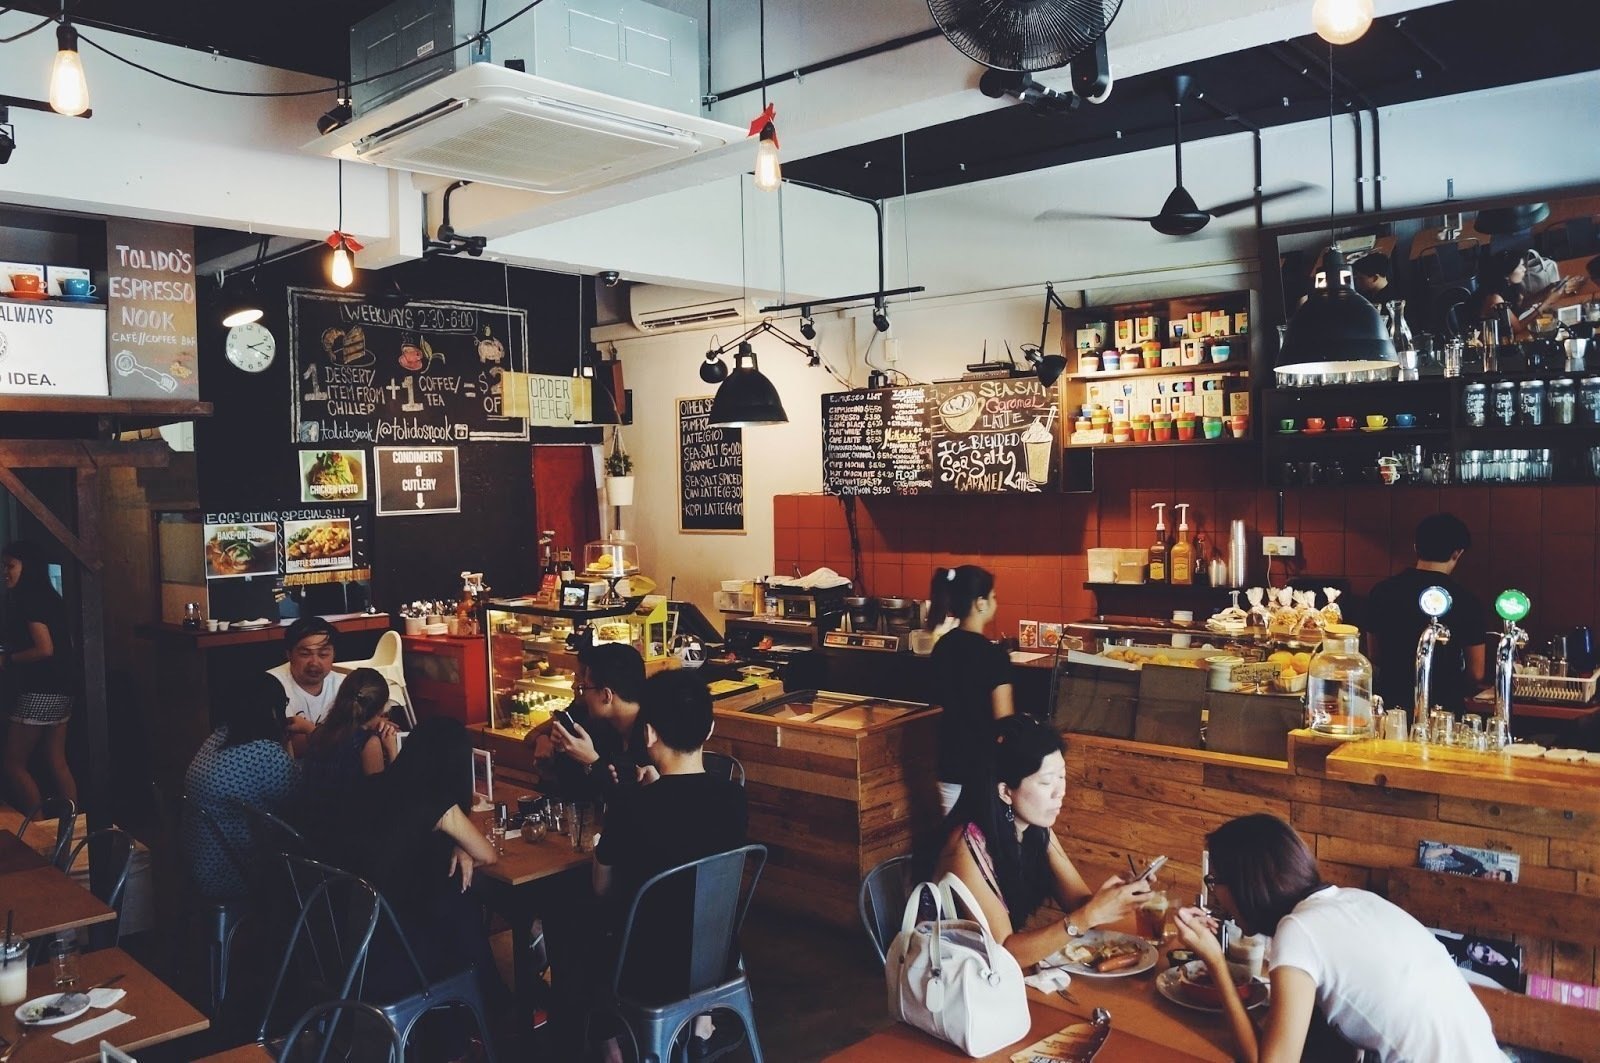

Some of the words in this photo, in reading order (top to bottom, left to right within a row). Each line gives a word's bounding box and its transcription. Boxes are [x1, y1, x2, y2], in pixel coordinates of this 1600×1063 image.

[115, 244, 192, 274] TOLIDO'S
[109, 276, 194, 304] ESPRESSO
[0, 305, 53, 325] ALWAYS
[121, 305, 176, 332] NOOK
[344, 303, 414, 329] WEEKDAYS
[8, 372, 56, 386] IDEA.
[303, 363, 328, 401] 1
[402, 375, 424, 412] 1
[530, 377, 570, 399] ORDER
[979, 381, 1014, 398] SEA
[1015, 381, 1046, 397] SALT
[327, 385, 355, 401] ITEM
[356, 386, 386, 405] FROM
[424, 393, 446, 407] TEA
[483, 396, 502, 413] OF
[327, 400, 376, 416] CHILLER
[680, 401, 704, 415] OTHER
[532, 400, 564, 420] HERE
[828, 420, 846, 428] LONG
[846, 420, 866, 429] BLACK
[982, 410, 1024, 429] LATTE
[968, 432, 1020, 450] BLENDED
[392, 451, 444, 464] CONDIMENTS
[684, 459, 718, 472] CARAMEL
[720, 456, 742, 467] LATTE
[415, 464, 423, 477] &
[718, 472, 742, 486] SPICED
[402, 478, 437, 491] CUTLERY
[954, 470, 1008, 492] CARAMEL
[685, 503, 702, 517] KOPI
